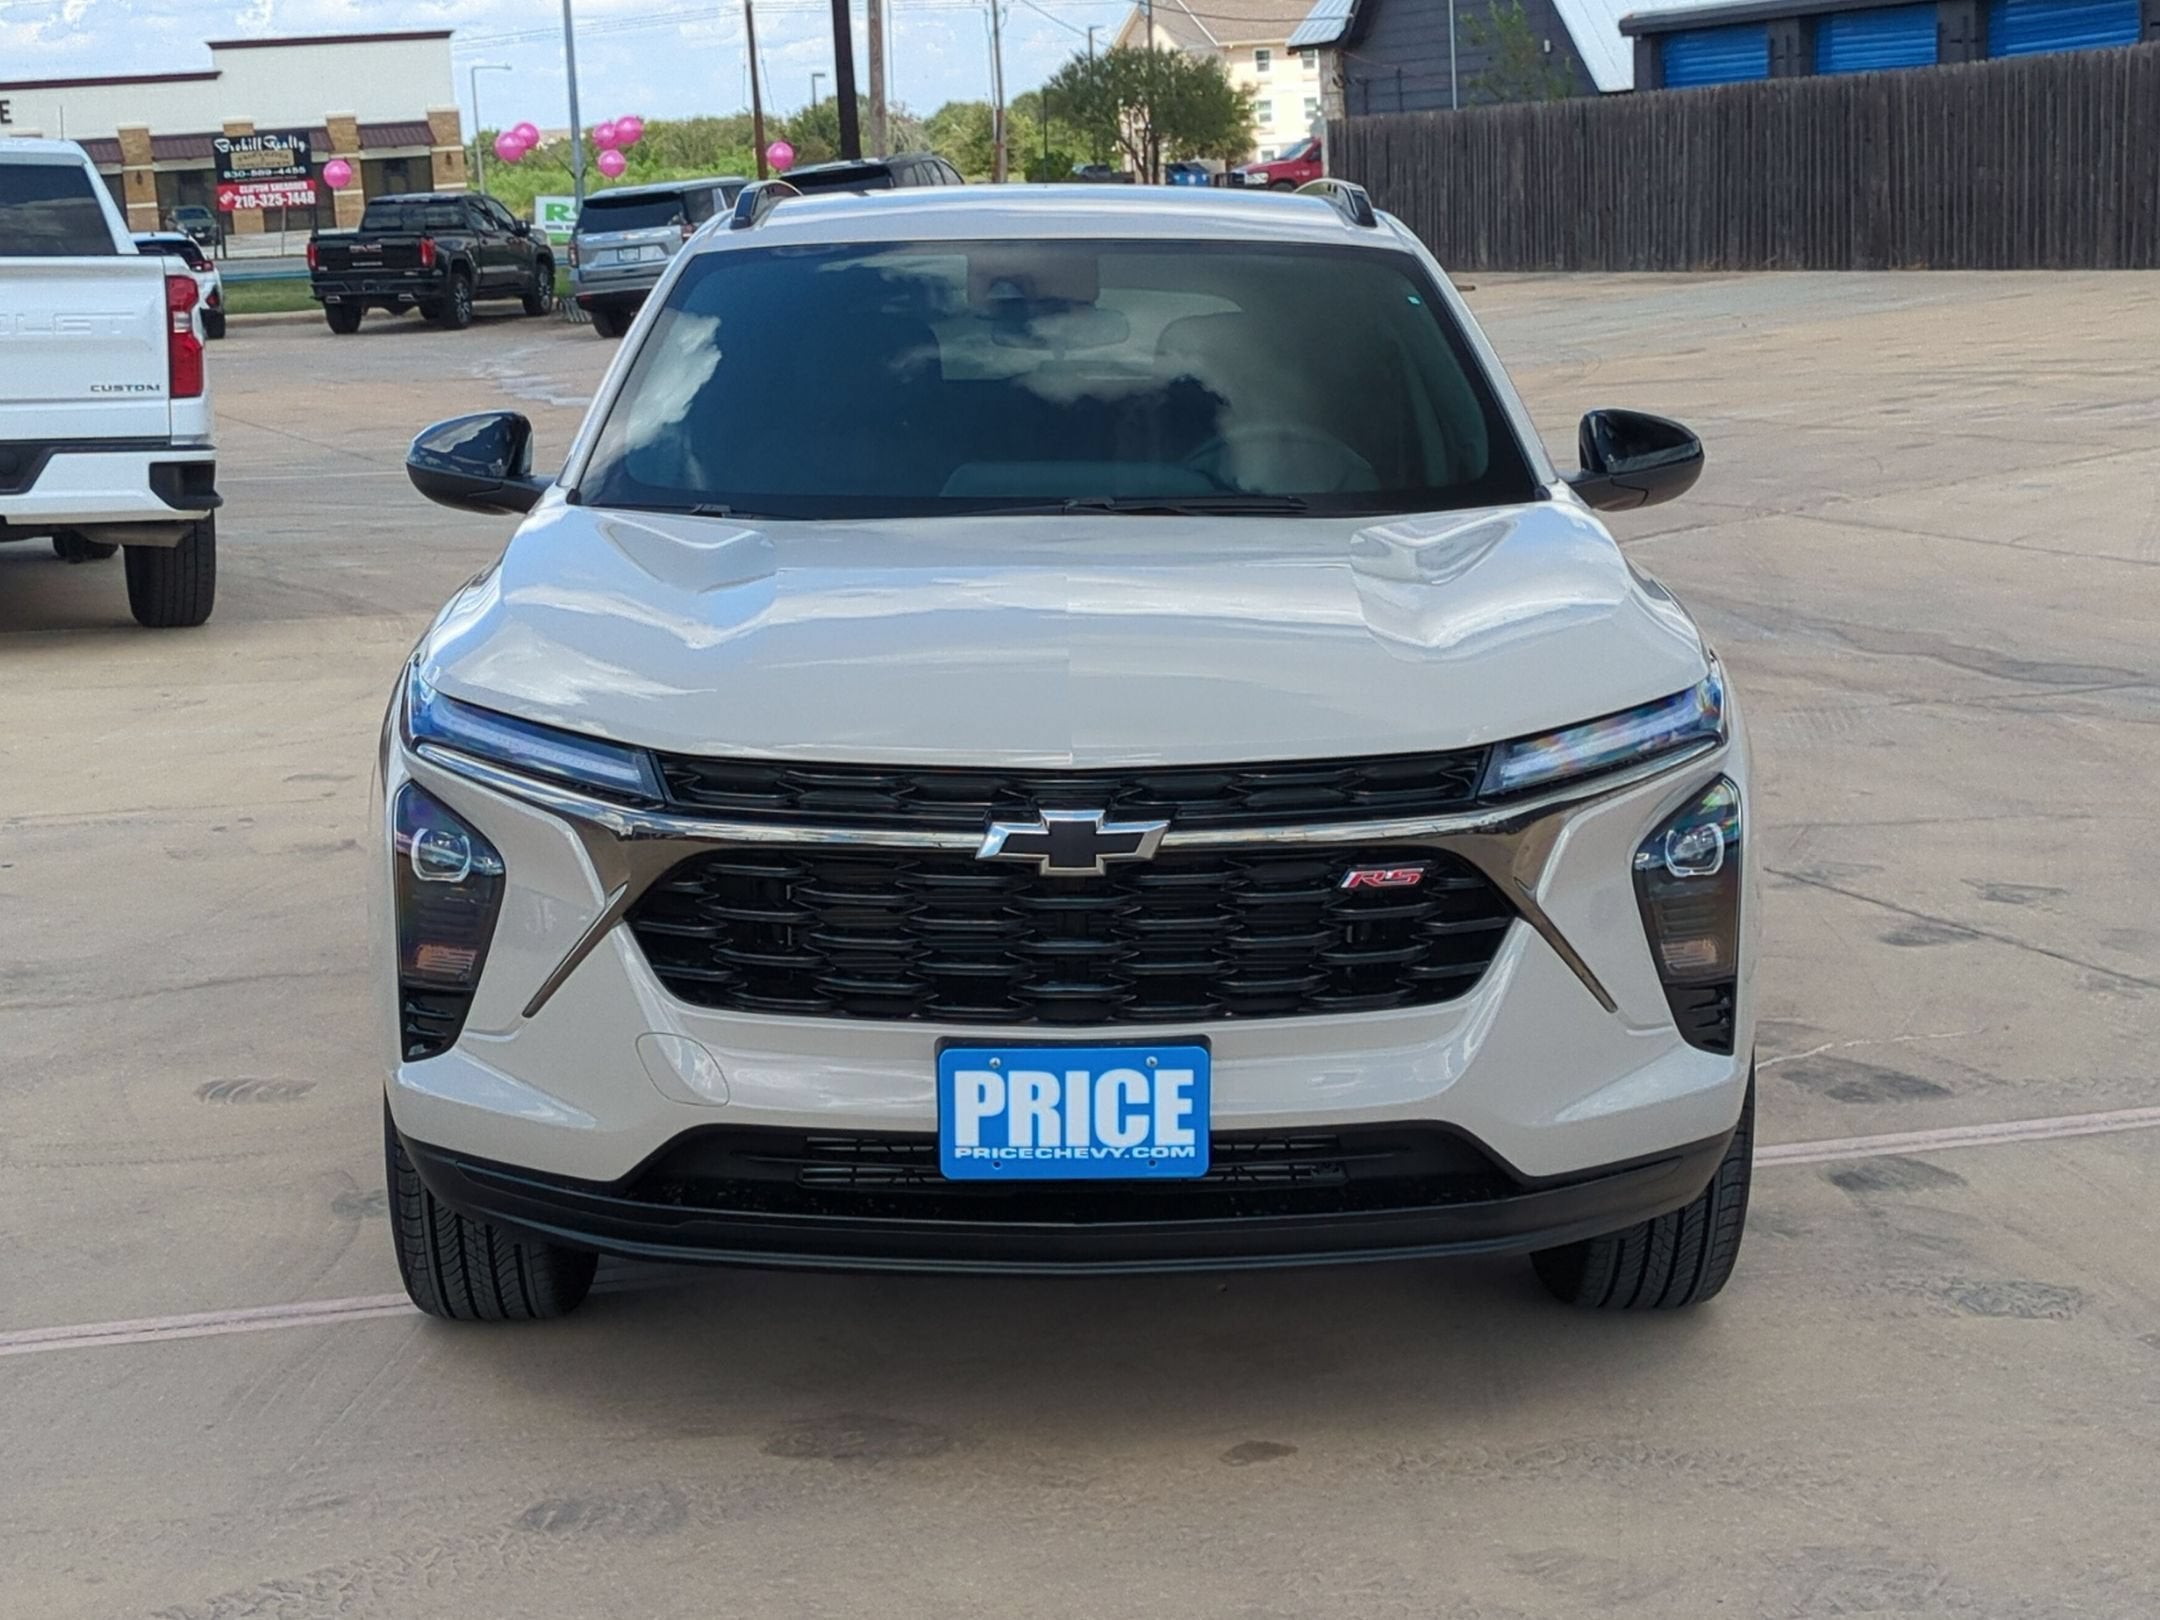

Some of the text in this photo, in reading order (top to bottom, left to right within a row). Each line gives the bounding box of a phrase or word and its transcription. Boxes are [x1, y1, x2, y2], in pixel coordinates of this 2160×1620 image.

[90, 383, 161, 393] CUSTOM
[1341, 867, 1424, 888] RS
[954, 1068, 1196, 1148] PRICE
[954, 1146, 1196, 1160] PRICECHEVY.COM
